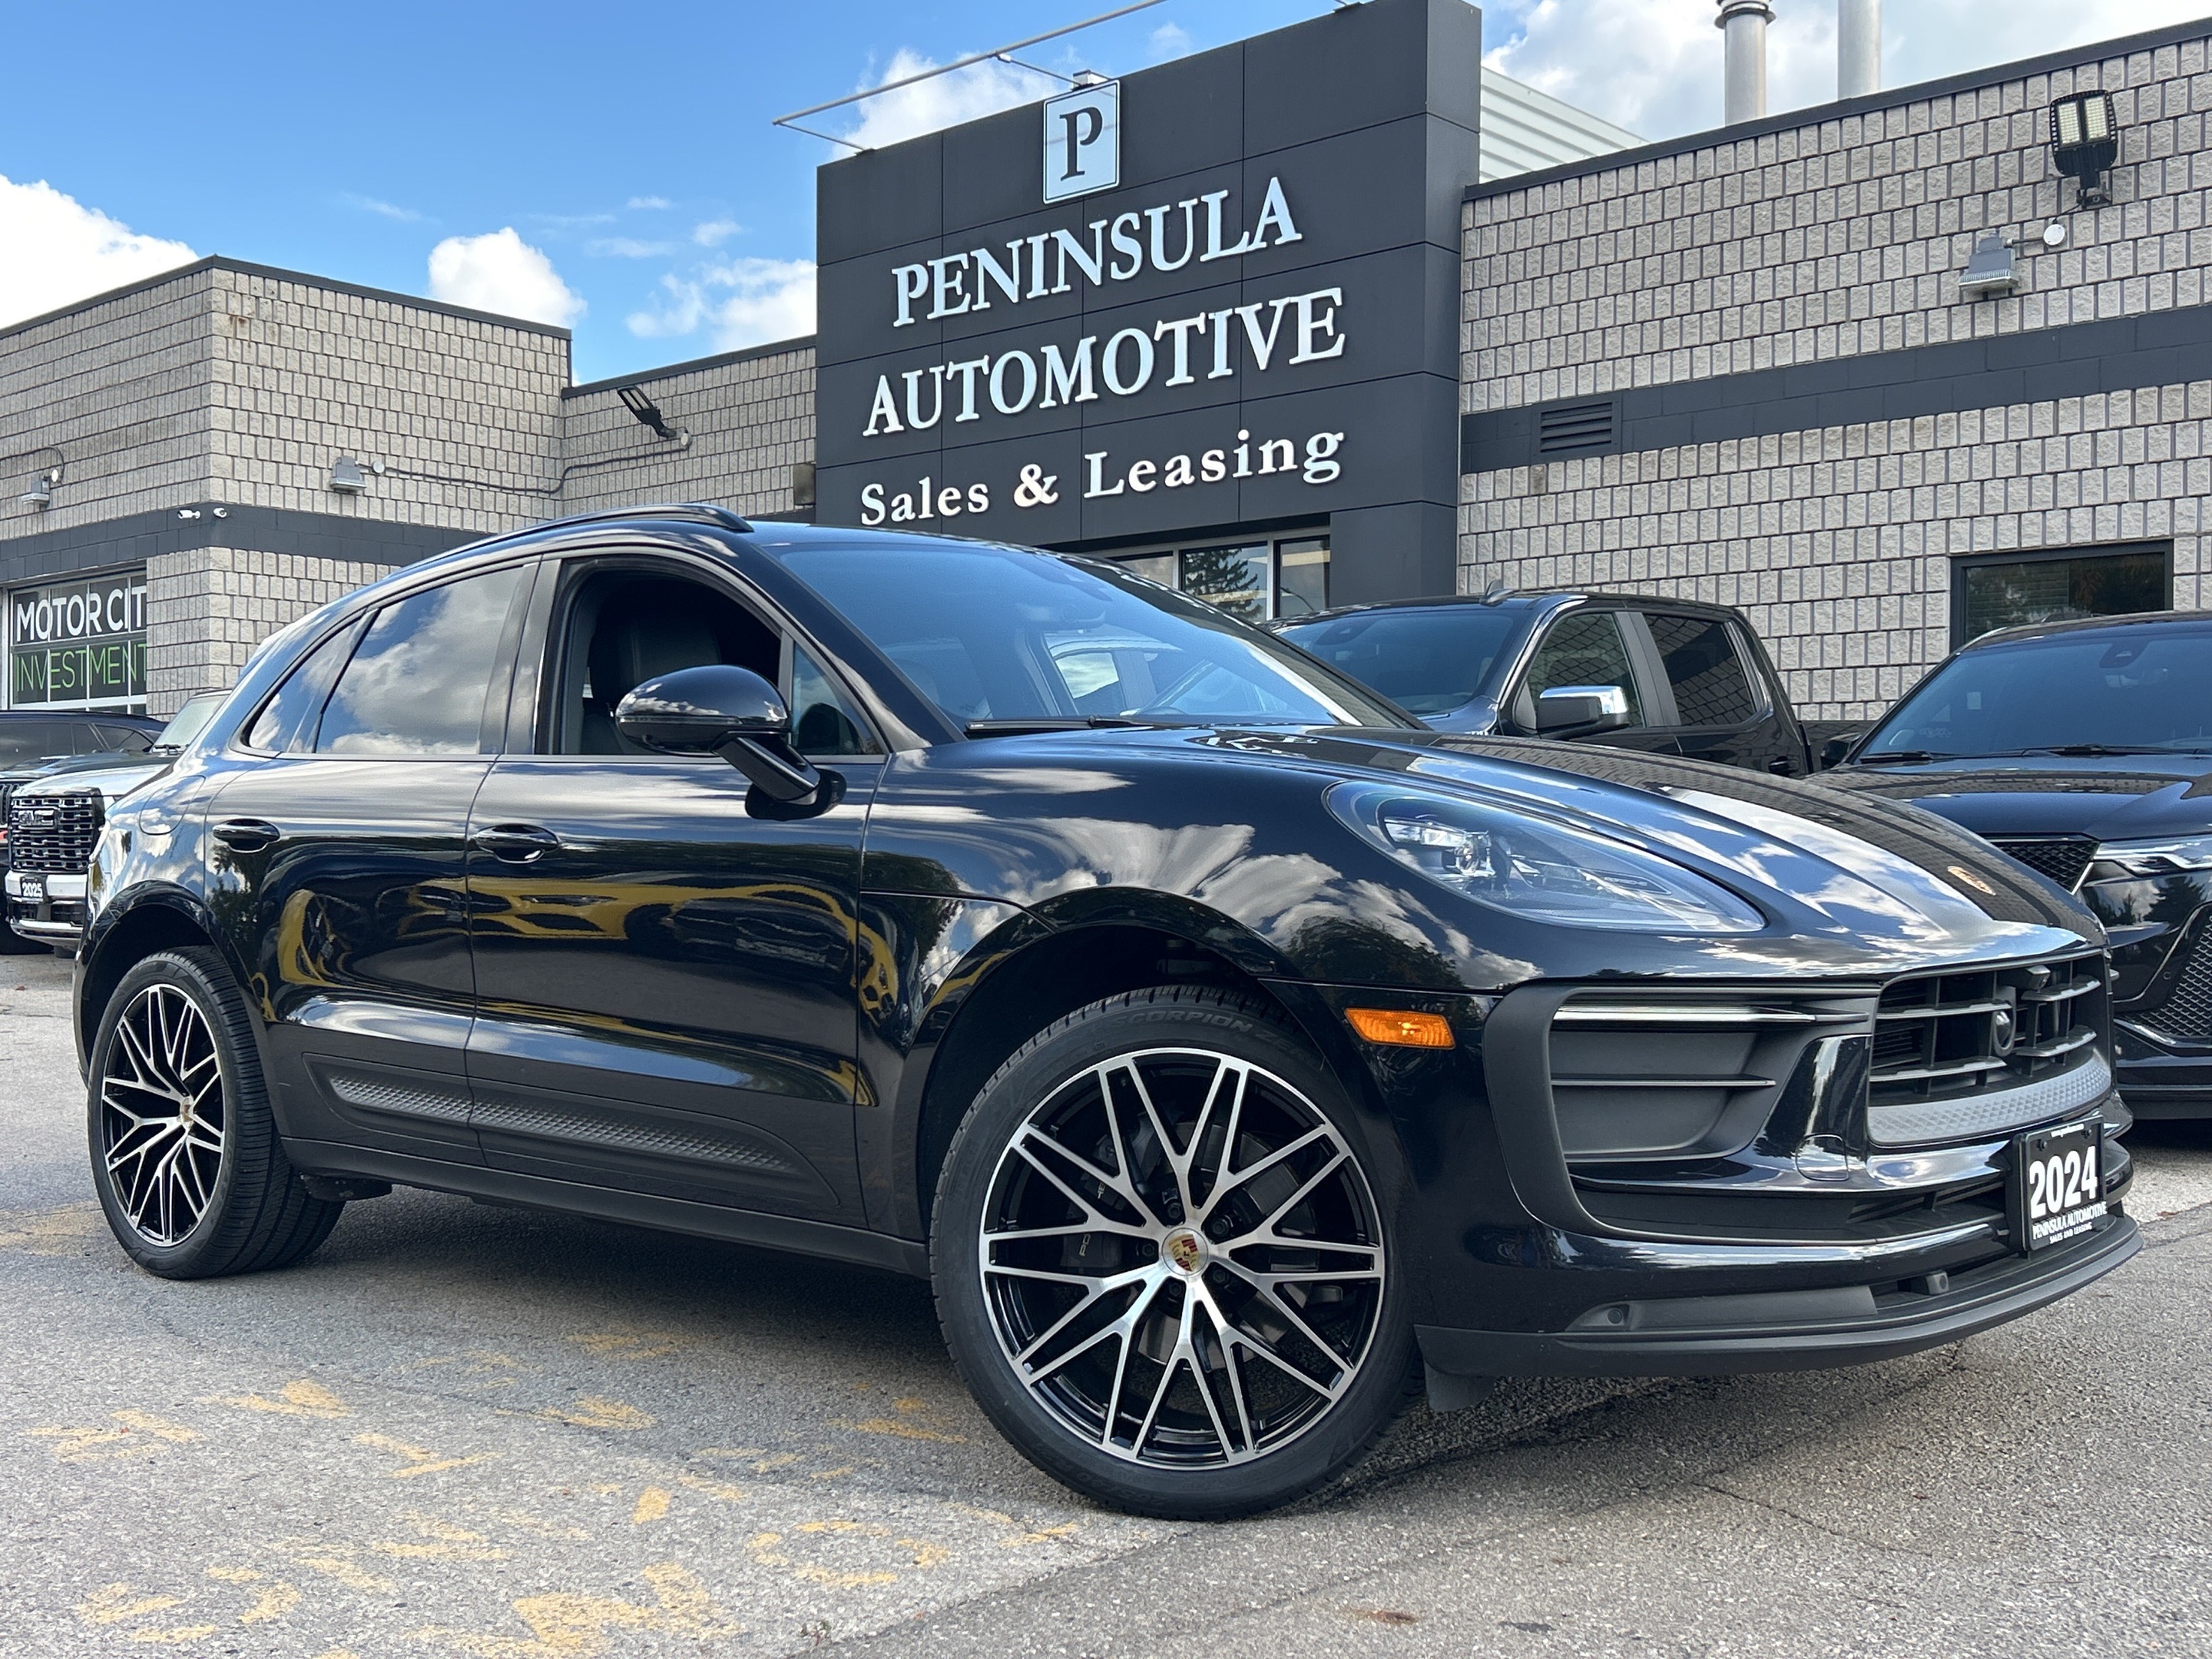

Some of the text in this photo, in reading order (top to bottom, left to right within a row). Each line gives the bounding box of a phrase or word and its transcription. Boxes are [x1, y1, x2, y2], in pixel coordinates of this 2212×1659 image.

[1058, 106, 1104, 183] P
[892, 176, 1303, 329] PENINSULA
[862, 287, 1346, 438] AUTOMOTIVE
[860, 429, 1345, 526] Sales & Leasing
[17, 592, 102, 642] MOTOR
[16, 644, 147, 692] INVESTMENT
[22, 882, 44, 898] 2025
[1111, 1009, 1253, 1033] SCORPION
[2029, 1145, 2098, 1220] 2024
[2032, 1200, 2108, 1240] PENINSULA AUTOMOTIVE
